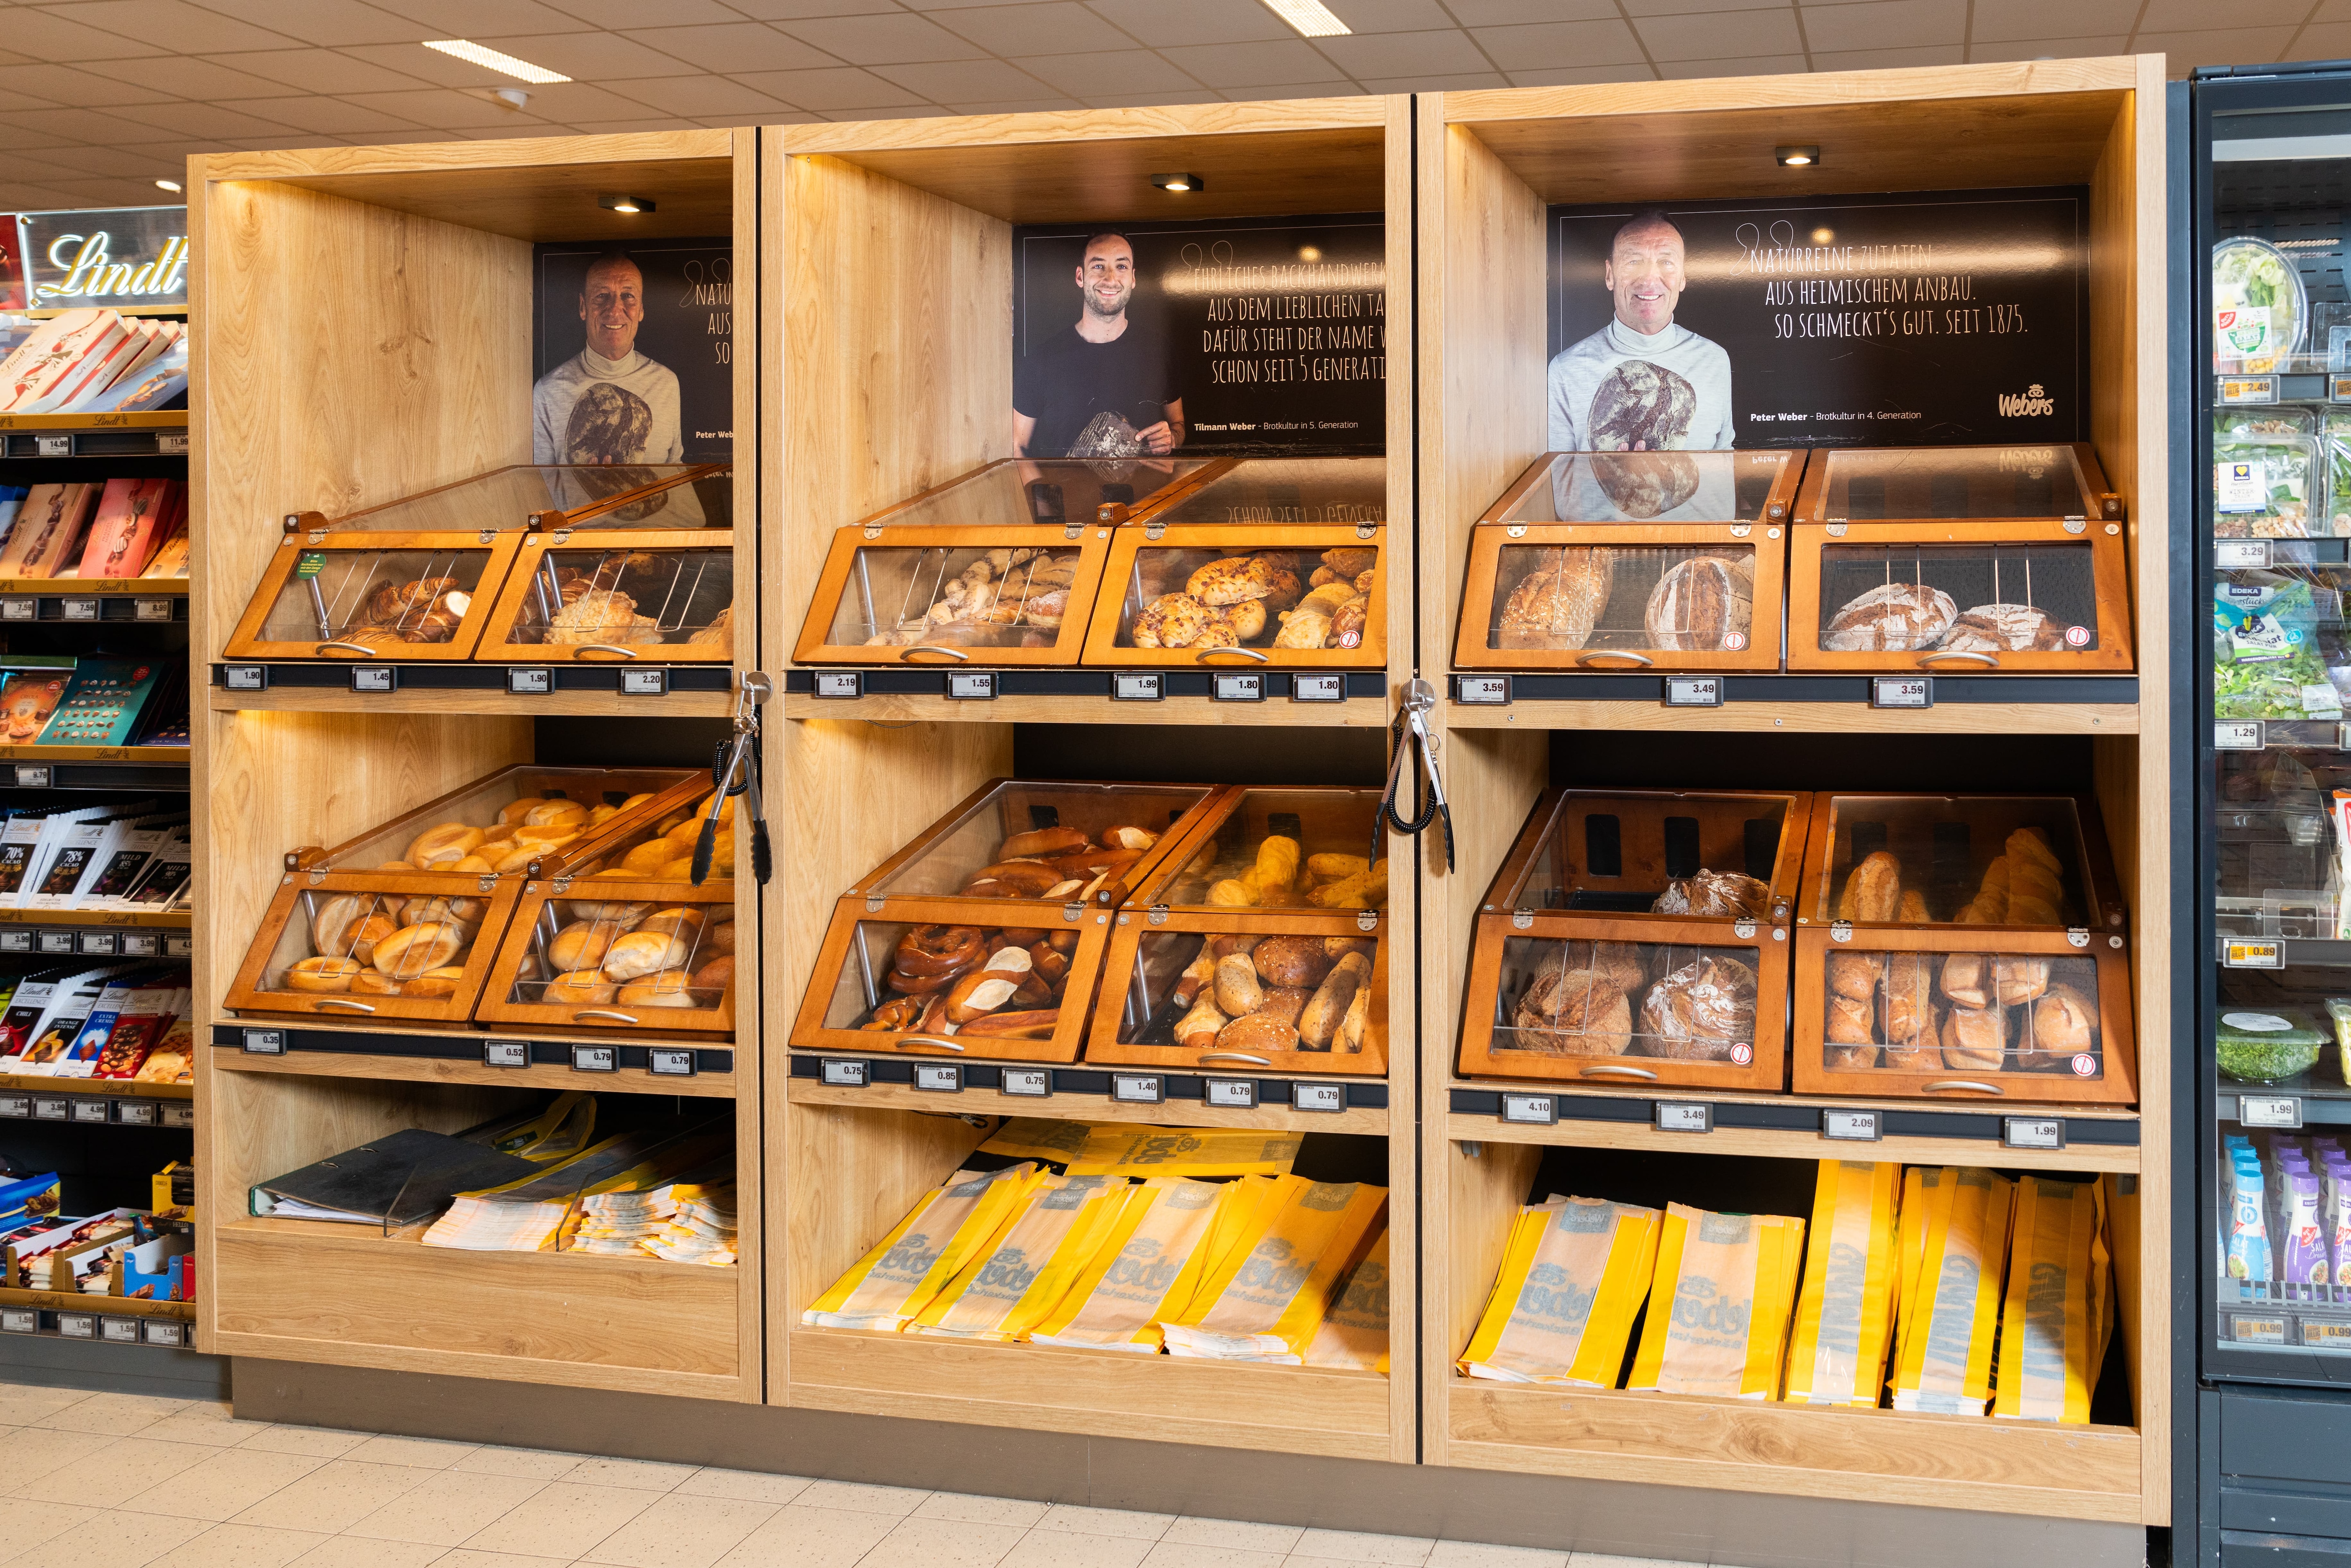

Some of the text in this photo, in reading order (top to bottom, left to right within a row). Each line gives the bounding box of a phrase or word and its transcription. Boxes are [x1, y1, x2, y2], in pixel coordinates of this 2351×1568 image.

[1751, 244, 1932, 273] NATURREINE ZUTATEN
[35, 231, 188, 298] Lindt
[1195, 265, 1265, 291] EHRLICHES
[696, 283, 731, 305] NATU
[1765, 276, 1976, 306] AUS HEIMISCHEM ANBAU.
[1208, 293, 1384, 321] AUS DEM LIEBLICHEN TA
[708, 312, 731, 334] AUS
[1775, 313, 1792, 339] SO
[1902, 309, 1939, 335] GUT.
[1946, 308, 1980, 334] SEIT
[1987, 304, 2028, 334] 1875.
[1204, 325, 1247, 352] DAFÜR
[1254, 327, 1292, 351] STEHT
[1298, 327, 1323, 350] DER
[1328, 326, 1374, 349] NAME
[2237, 334, 2258, 342] SALAT
[716, 342, 730, 364] SO
[1212, 360, 1258, 383] SCHON
[1264, 358, 1294, 382] SEIT
[1300, 355, 1308, 381] 5
[2225, 387, 2240, 396] BILLIG
[2248, 383, 2270, 391] 2.49
[1999, 393, 2053, 418] Webers
[93, 414, 120, 426] Lindt
[1751, 413, 1776, 422] Peter
[1778, 412, 1808, 421] Weber
[1816, 412, 1855, 420] Brotkultur
[1877, 411, 1921, 419] Generation
[1194, 423, 1227, 431] Tilmann
[1230, 422, 1256, 431] Weber
[2241, 547, 2264, 556] 3.29
[94, 580, 122, 591] Lindt
[643, 675, 660, 683] 2.20
[1138, 680, 1157, 688] 1.99
[1239, 680, 1258, 689] 1.80
[1319, 681, 1338, 689] 1.80
[1483, 683, 1503, 692] 3.59
[1693, 684, 1714, 693] 3.49
[1901, 685, 1923, 694] 3.59
[95, 748, 122, 759] Lindt
[10, 821, 35, 832] Lindt
[6, 847, 25, 859] 70%
[63, 851, 85, 862] 78%
[103, 913, 132, 925] Lindt
[2231, 950, 2245, 959] BILLIG
[2253, 946, 2275, 956] 0.89
[21, 985, 46, 995] Lindt
[263, 1036, 278, 1044] 0.35
[506, 1048, 523, 1056] 0.52
[594, 1052, 611, 1061] 0.79
[671, 1056, 689, 1064] 0.79
[844, 1066, 861, 1075] 0.75
[938, 1072, 955, 1080] 0.85
[1026, 1076, 1044, 1085] 0.75
[101, 1082, 129, 1094] Lindt
[1137, 1082, 1157, 1091] 1.40
[1230, 1086, 1250, 1095] 0.79
[1318, 1090, 1338, 1100] 0.79
[1529, 1102, 1549, 1111] 4.10
[2270, 1104, 2292, 1114] 1.99
[1683, 1110, 1704, 1119] 3.49
[1852, 1118, 1873, 1127] 2.09
[2035, 1126, 2056, 1135] 1.99
[29, 1294, 56, 1306] Lindt
[148, 1303, 177, 1315] Lindt
[77, 1321, 92, 1329] 1.59
[2259, 1323, 2282, 1333] 0.99
[2238, 1327, 2251, 1335] BILLIG
[2306, 1330, 2320, 1339] BILLIG
[2328, 1326, 2351, 1337] 0.99
